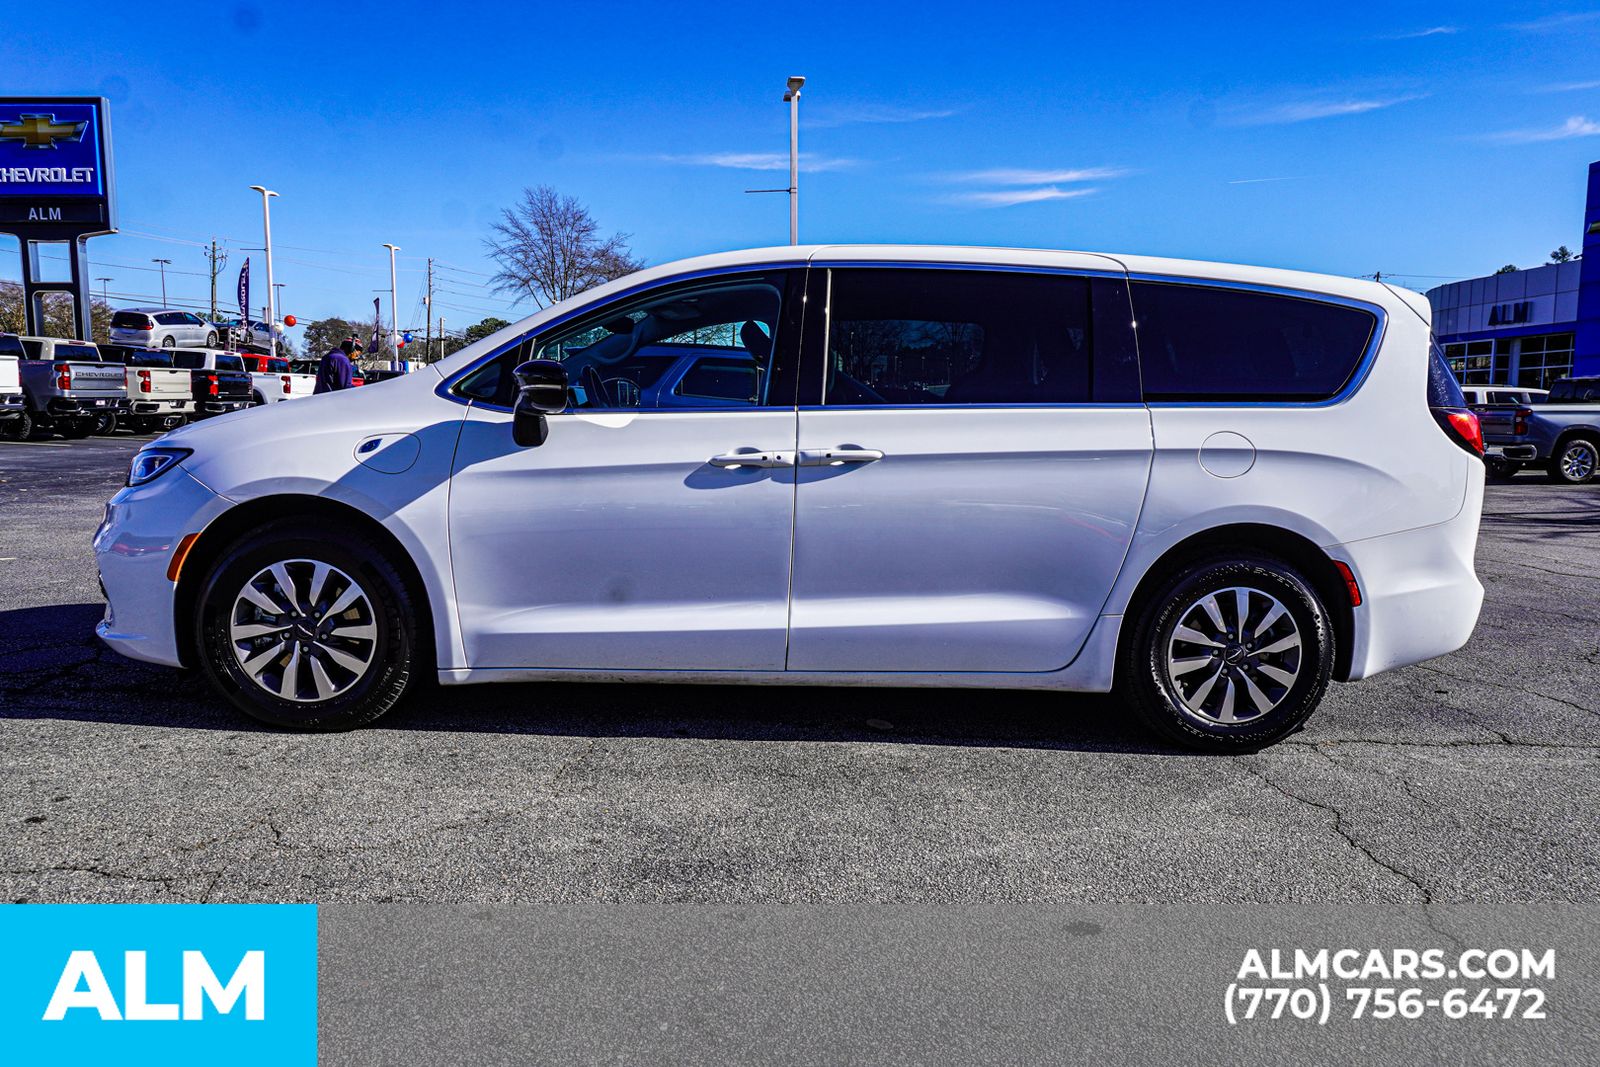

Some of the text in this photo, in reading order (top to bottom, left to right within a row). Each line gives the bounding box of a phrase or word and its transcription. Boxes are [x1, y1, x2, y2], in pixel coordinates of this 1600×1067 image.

[0, 167, 94, 183] HEVROLET
[28, 207, 62, 221] ALM
[1487, 301, 1529, 326] ALM
